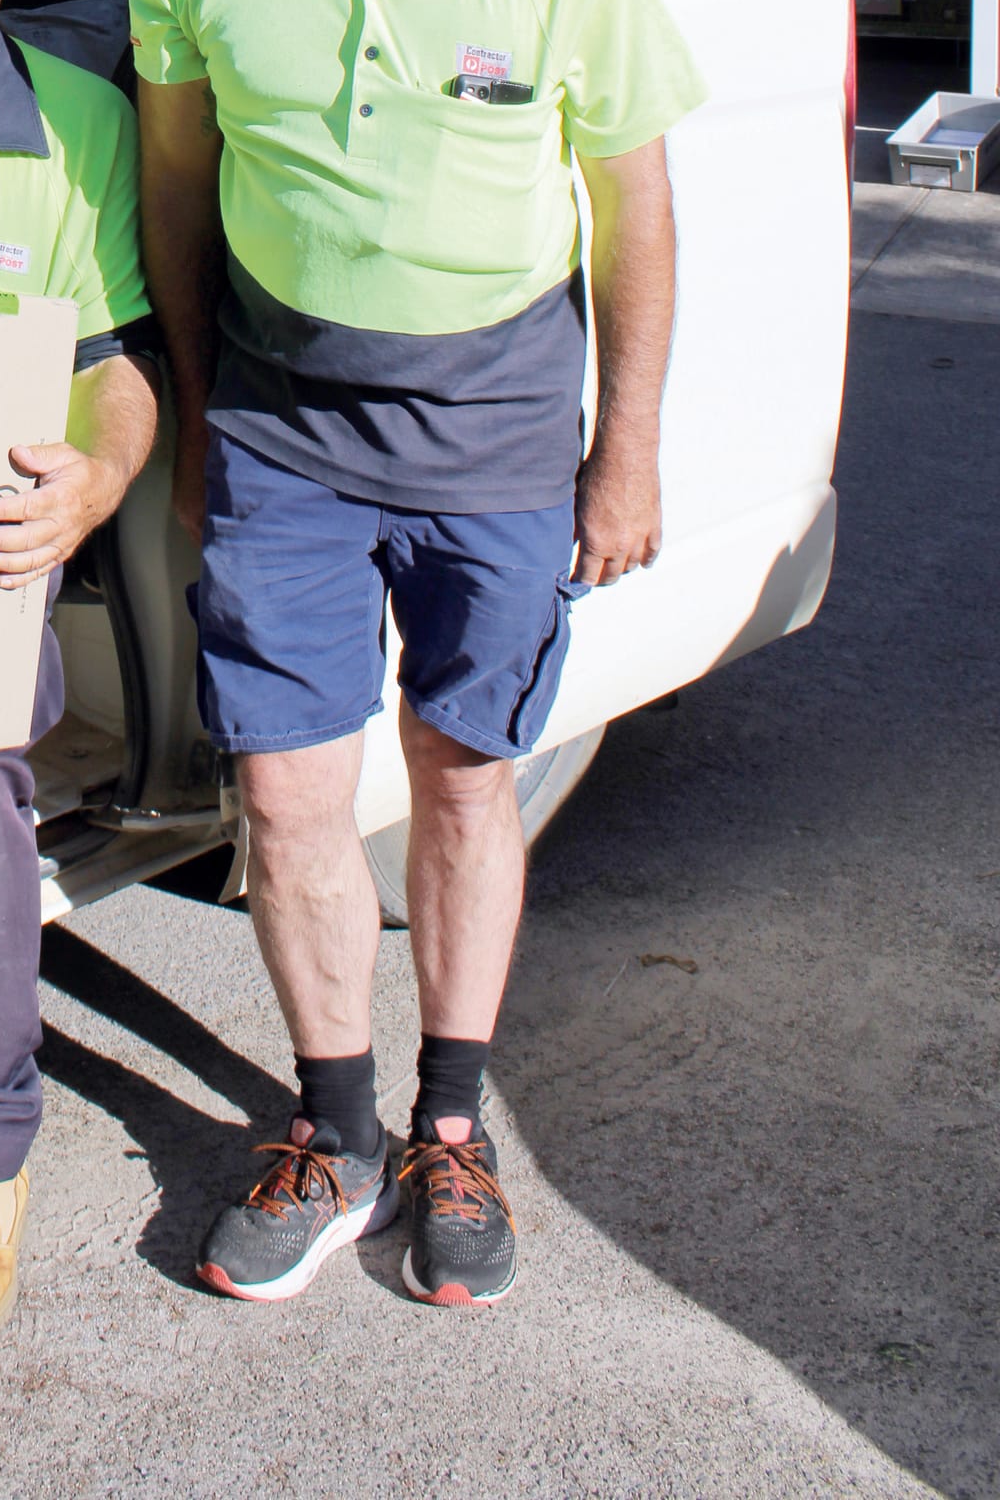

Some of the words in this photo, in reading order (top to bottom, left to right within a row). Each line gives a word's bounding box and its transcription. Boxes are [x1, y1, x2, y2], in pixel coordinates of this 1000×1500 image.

[467, 45, 506, 61] Contractor
[481, 62, 507, 76] POST
[0, 257, 24, 269] POST
